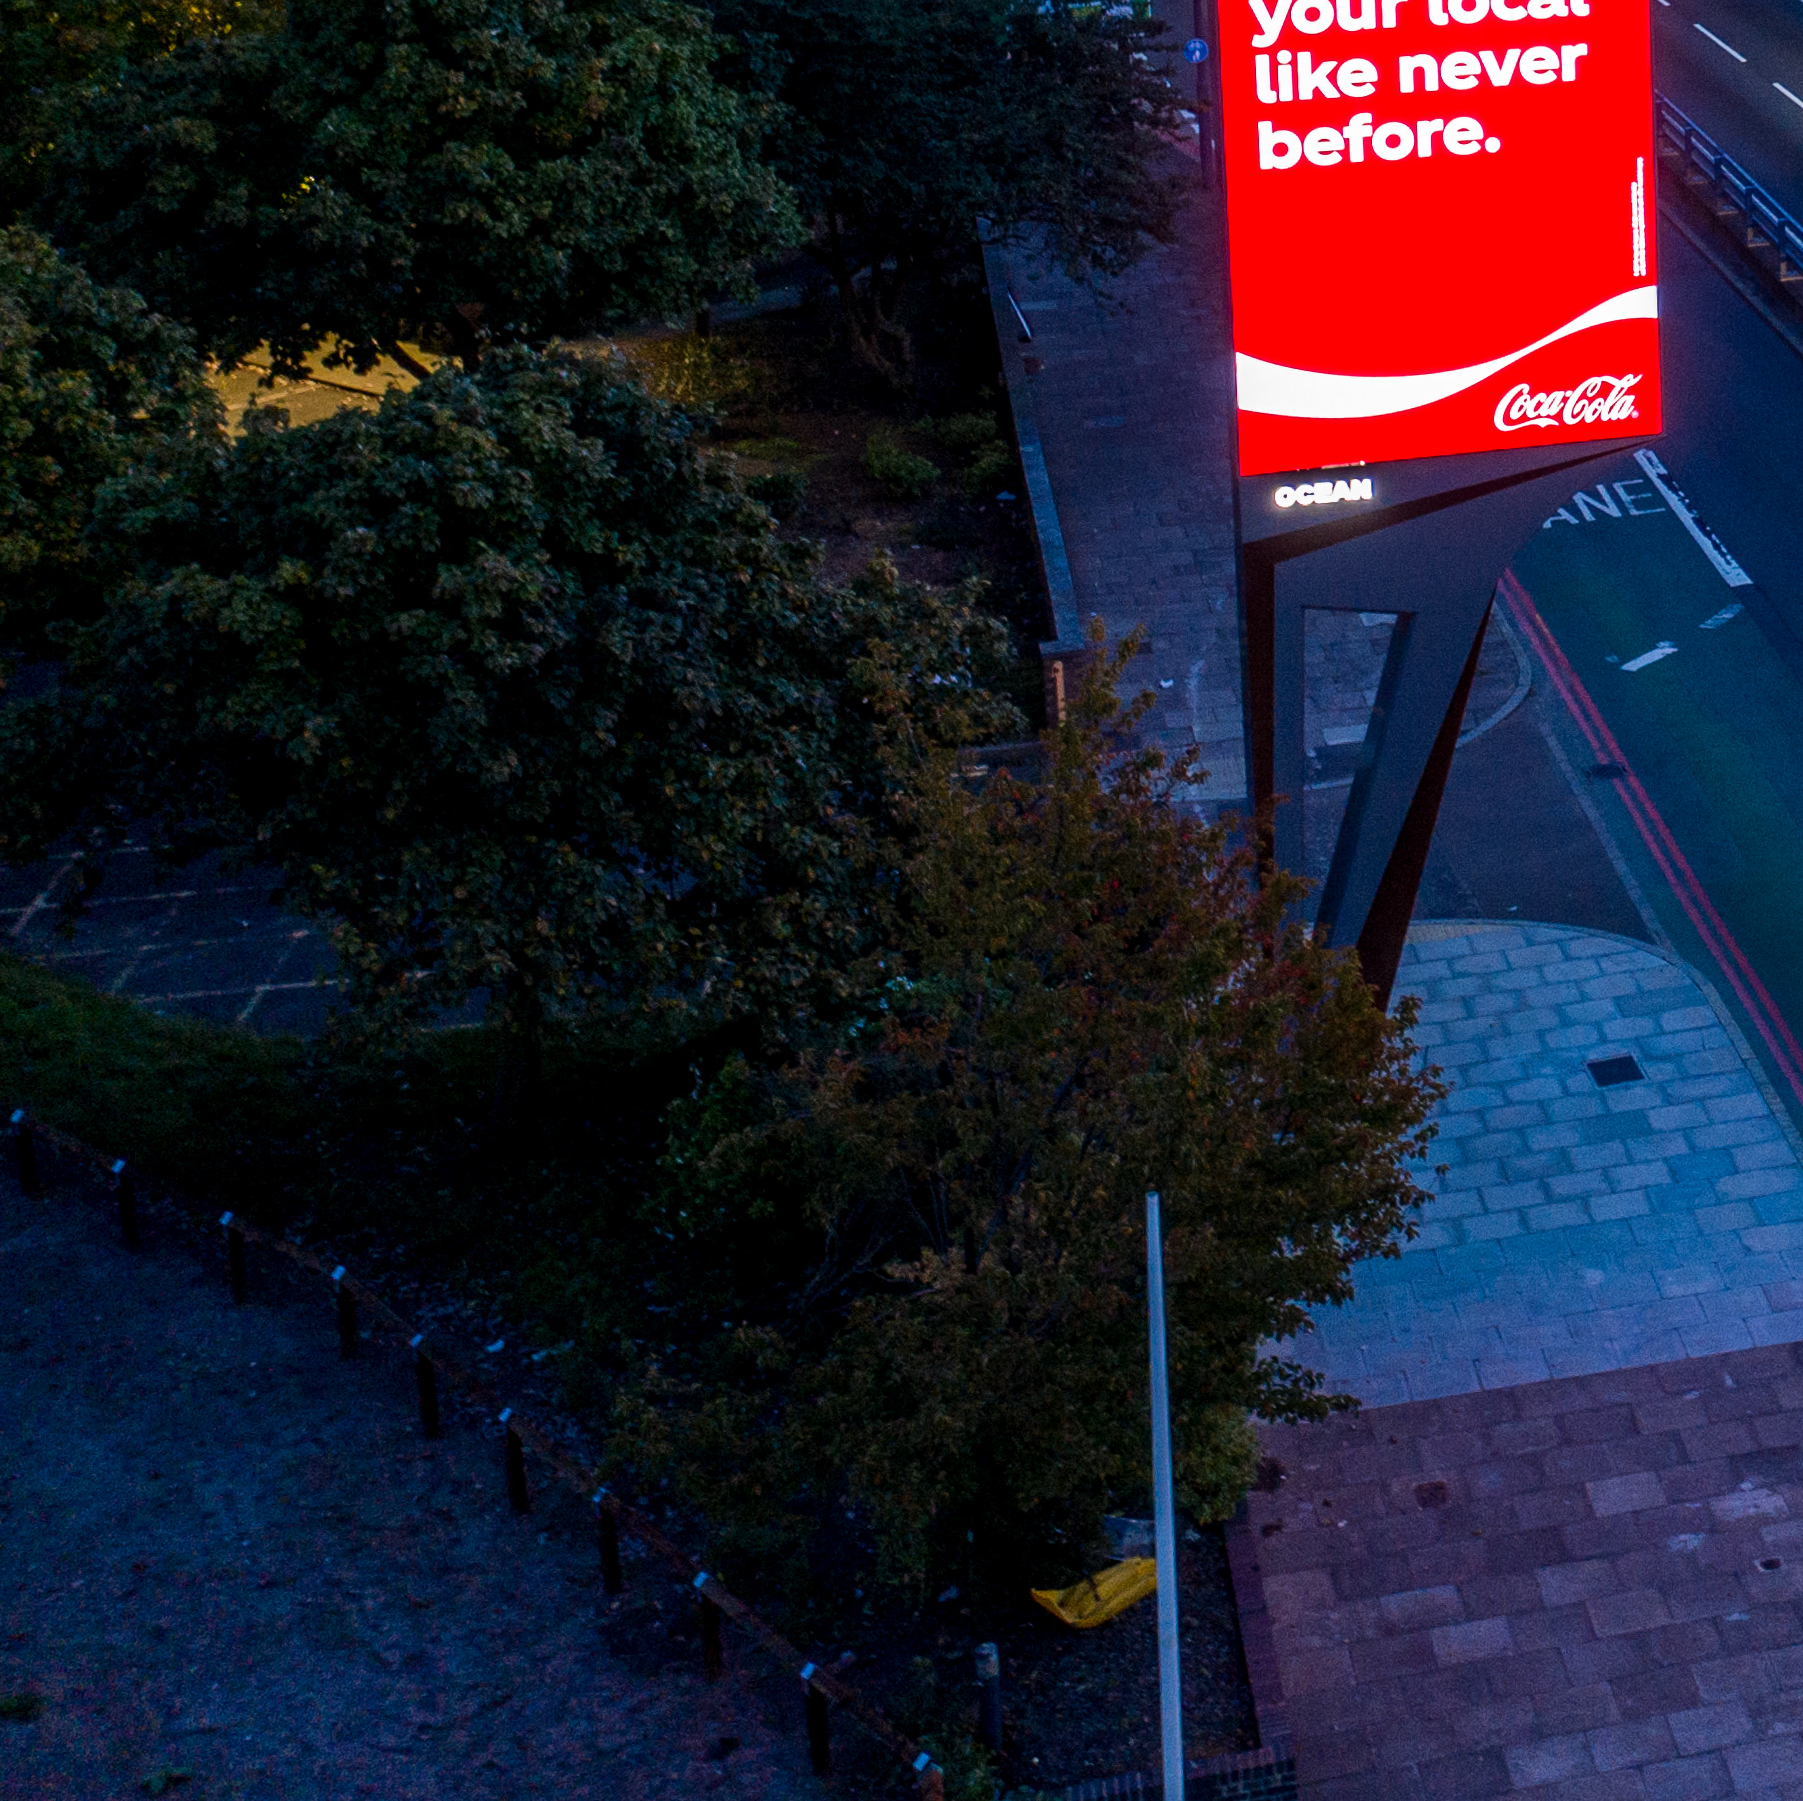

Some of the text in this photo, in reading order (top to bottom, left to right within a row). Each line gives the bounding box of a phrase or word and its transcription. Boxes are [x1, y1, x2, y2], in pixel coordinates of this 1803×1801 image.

[1254, 43, 1588, 104] like never
[1257, 113, 1501, 170] before.
[1494, 374, 1643, 432] Coca-Cola
[1275, 479, 1373, 508] OCEAN
